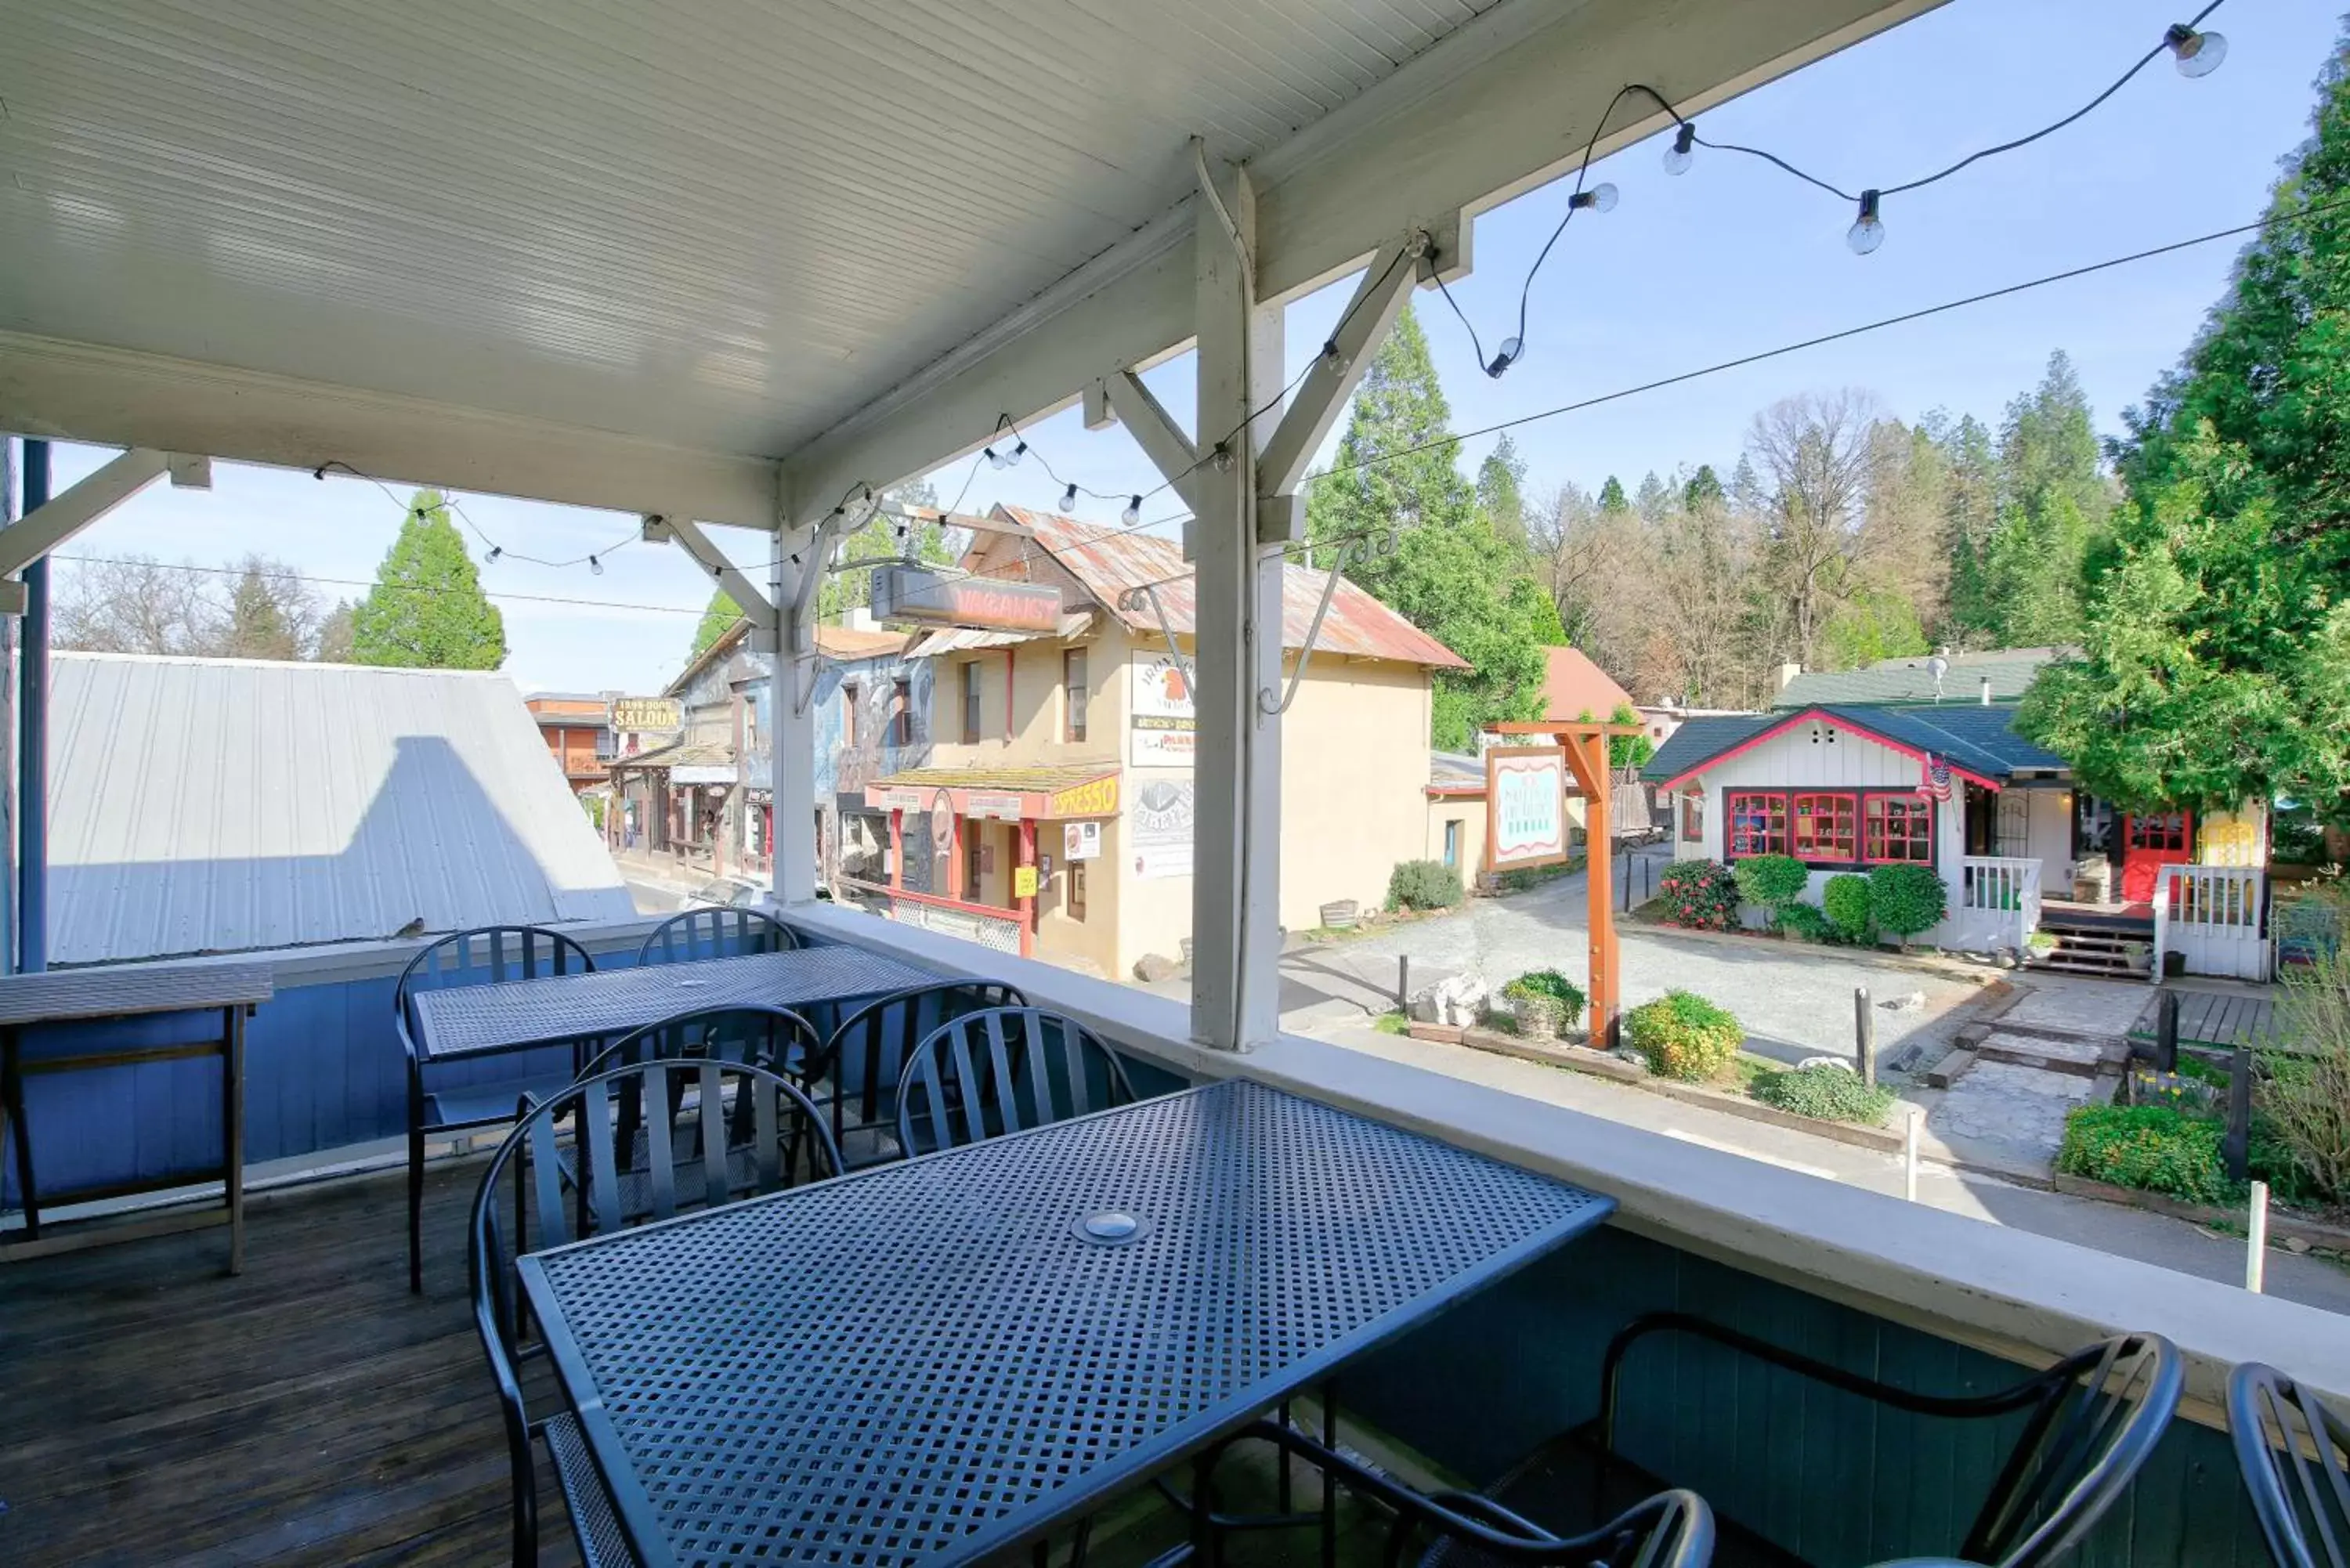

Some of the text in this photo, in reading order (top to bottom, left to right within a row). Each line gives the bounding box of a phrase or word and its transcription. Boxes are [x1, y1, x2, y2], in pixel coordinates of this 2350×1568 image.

[956, 588, 1059, 620] VACANCY
[615, 710, 678, 726] SALOON
[1054, 777, 1116, 815] ESPRESSO
